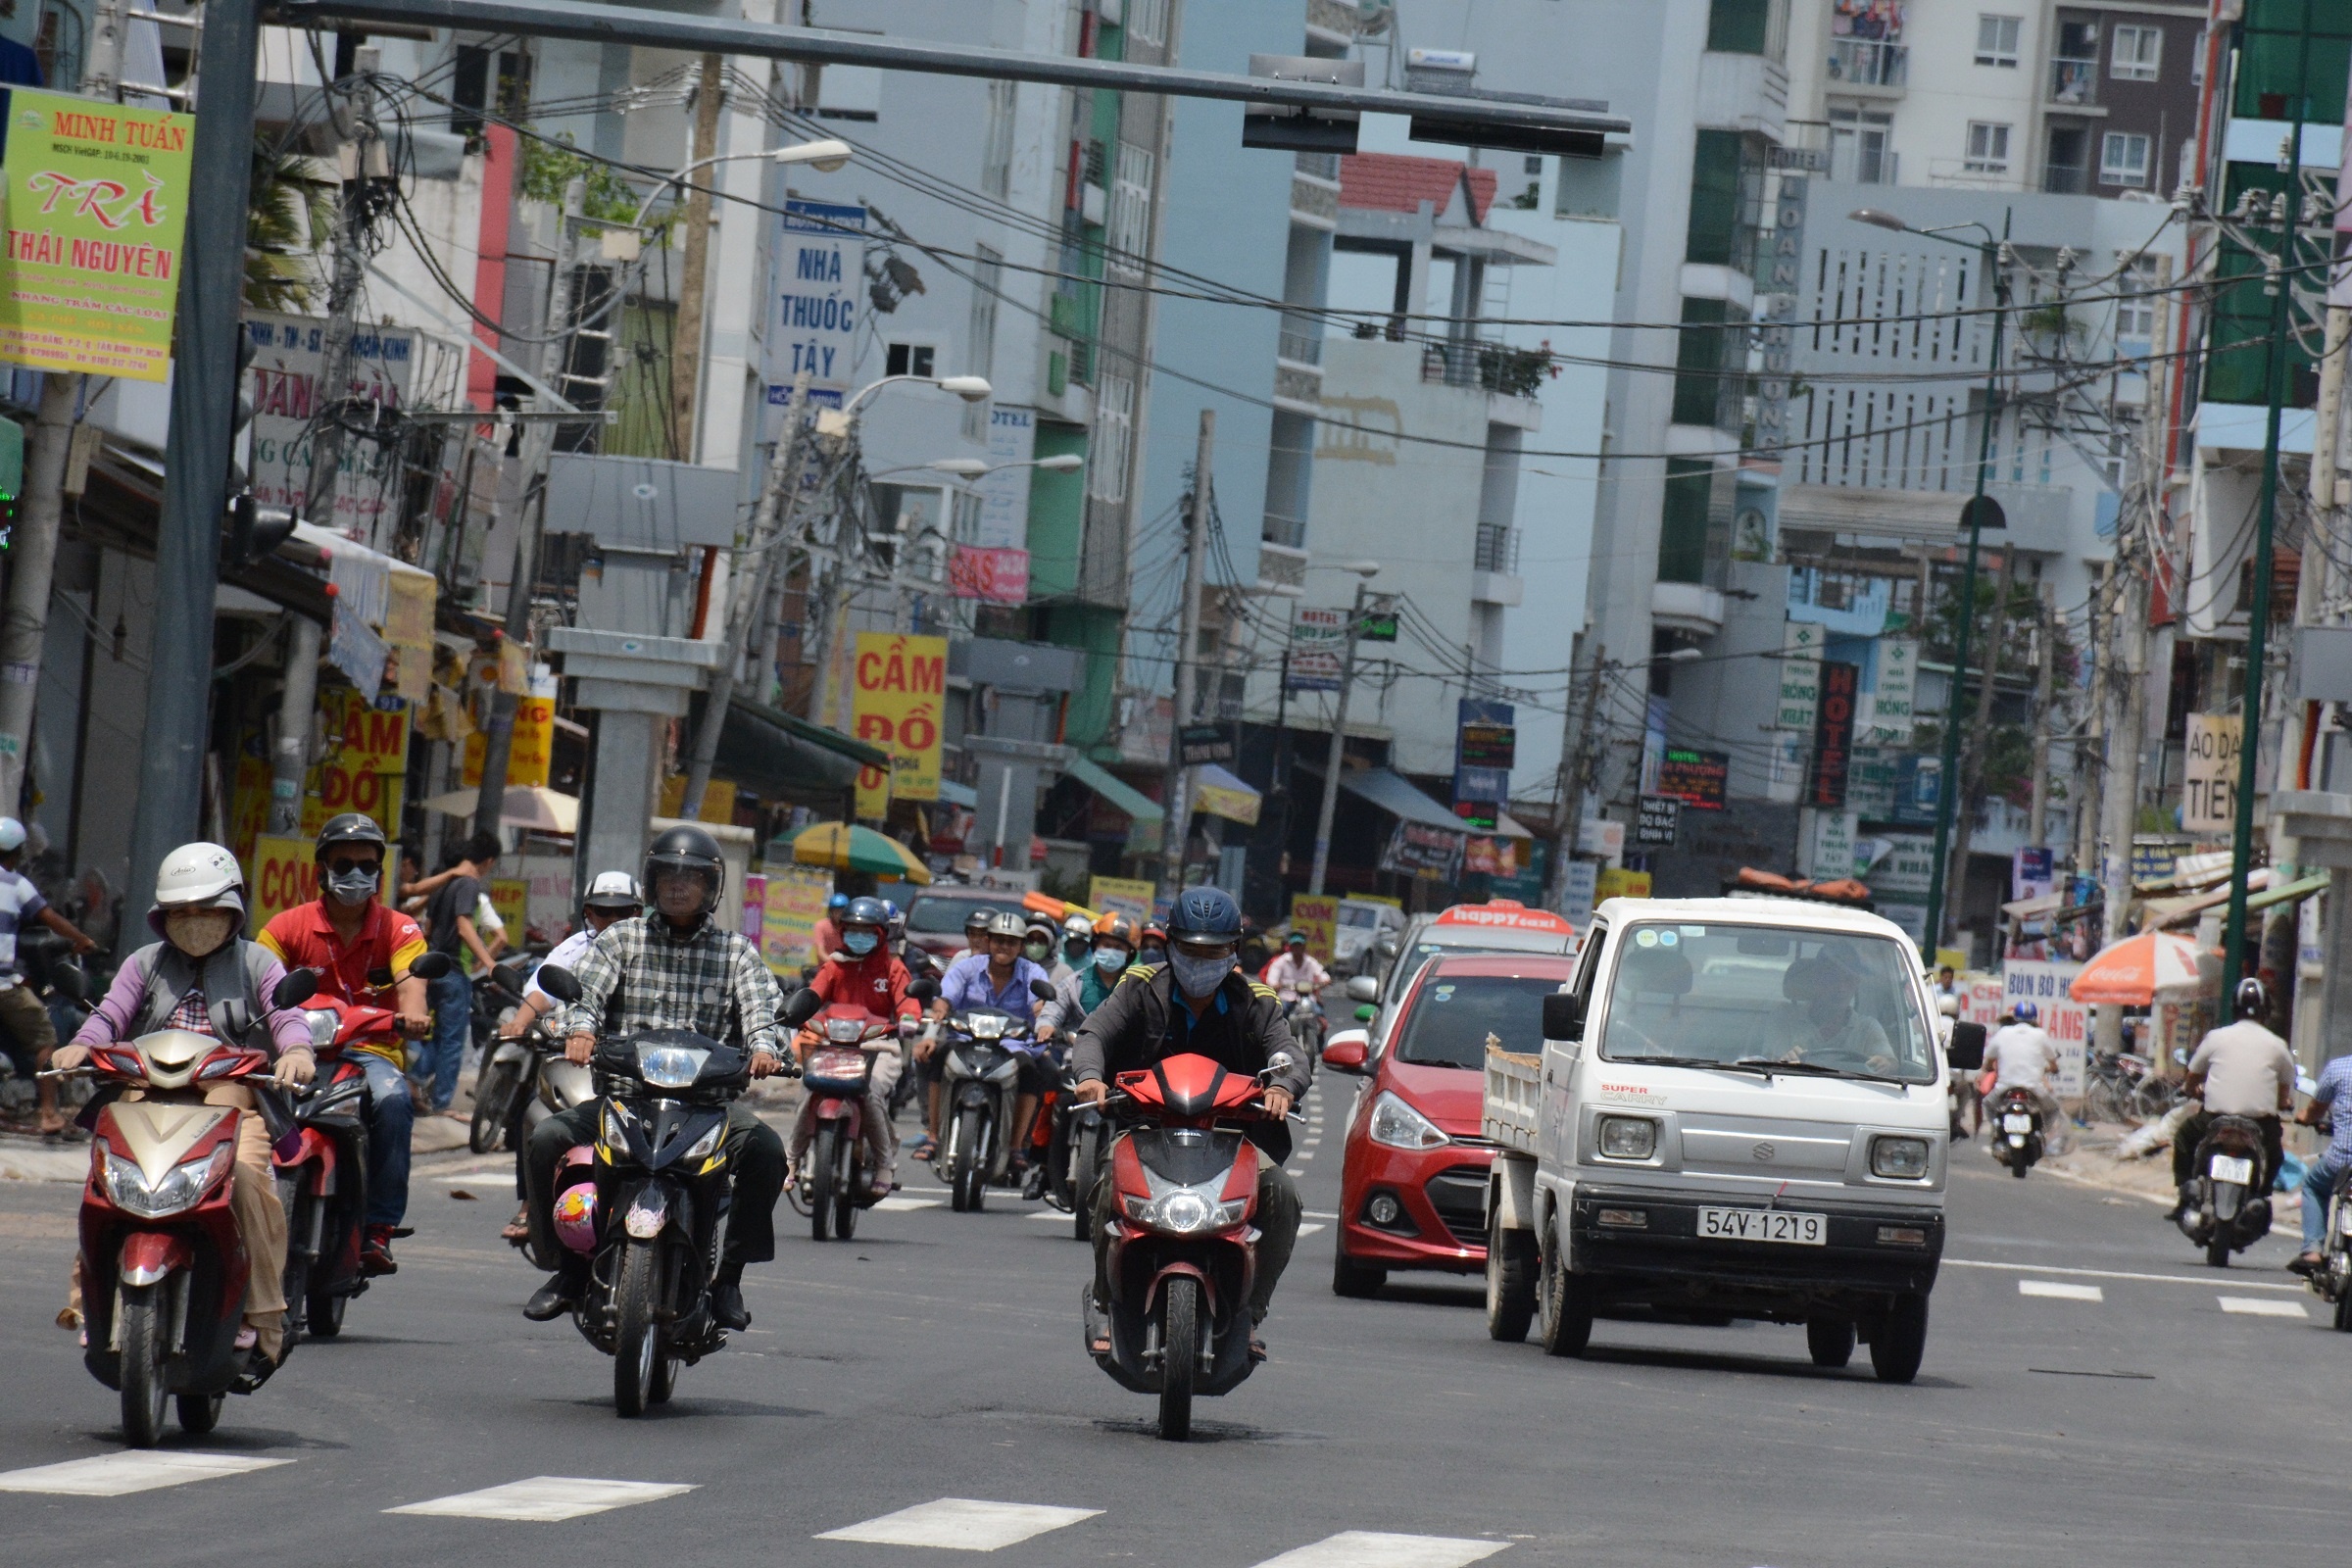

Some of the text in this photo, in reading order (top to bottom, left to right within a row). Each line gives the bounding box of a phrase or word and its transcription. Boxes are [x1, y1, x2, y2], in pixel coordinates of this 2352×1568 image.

[54, 112, 187, 153] MINH TUẤN
[28, 169, 167, 231] TRÀ
[7, 227, 64, 266] THÁI
[71, 241, 174, 281] NGUYÊN
[798, 242, 842, 282] NHÀ
[782, 290, 854, 331] THUỐC
[793, 338, 835, 377] TÂY
[858, 636, 944, 695] CẦM
[858, 703, 936, 752] ĐỒ
[1818, 667, 1853, 804] HOTEL
[2189, 725, 2241, 760] ÁO DÀ
[1453, 907, 1556, 928] happy taxi
[2009, 968, 2034, 996] BÚN
[2038, 970, 2054, 998] BÒ
[1600, 1092, 1668, 1105] CARRY
[1601, 1084, 1647, 1094] SUPER
[1706, 1211, 1818, 1241] 54V-1219
